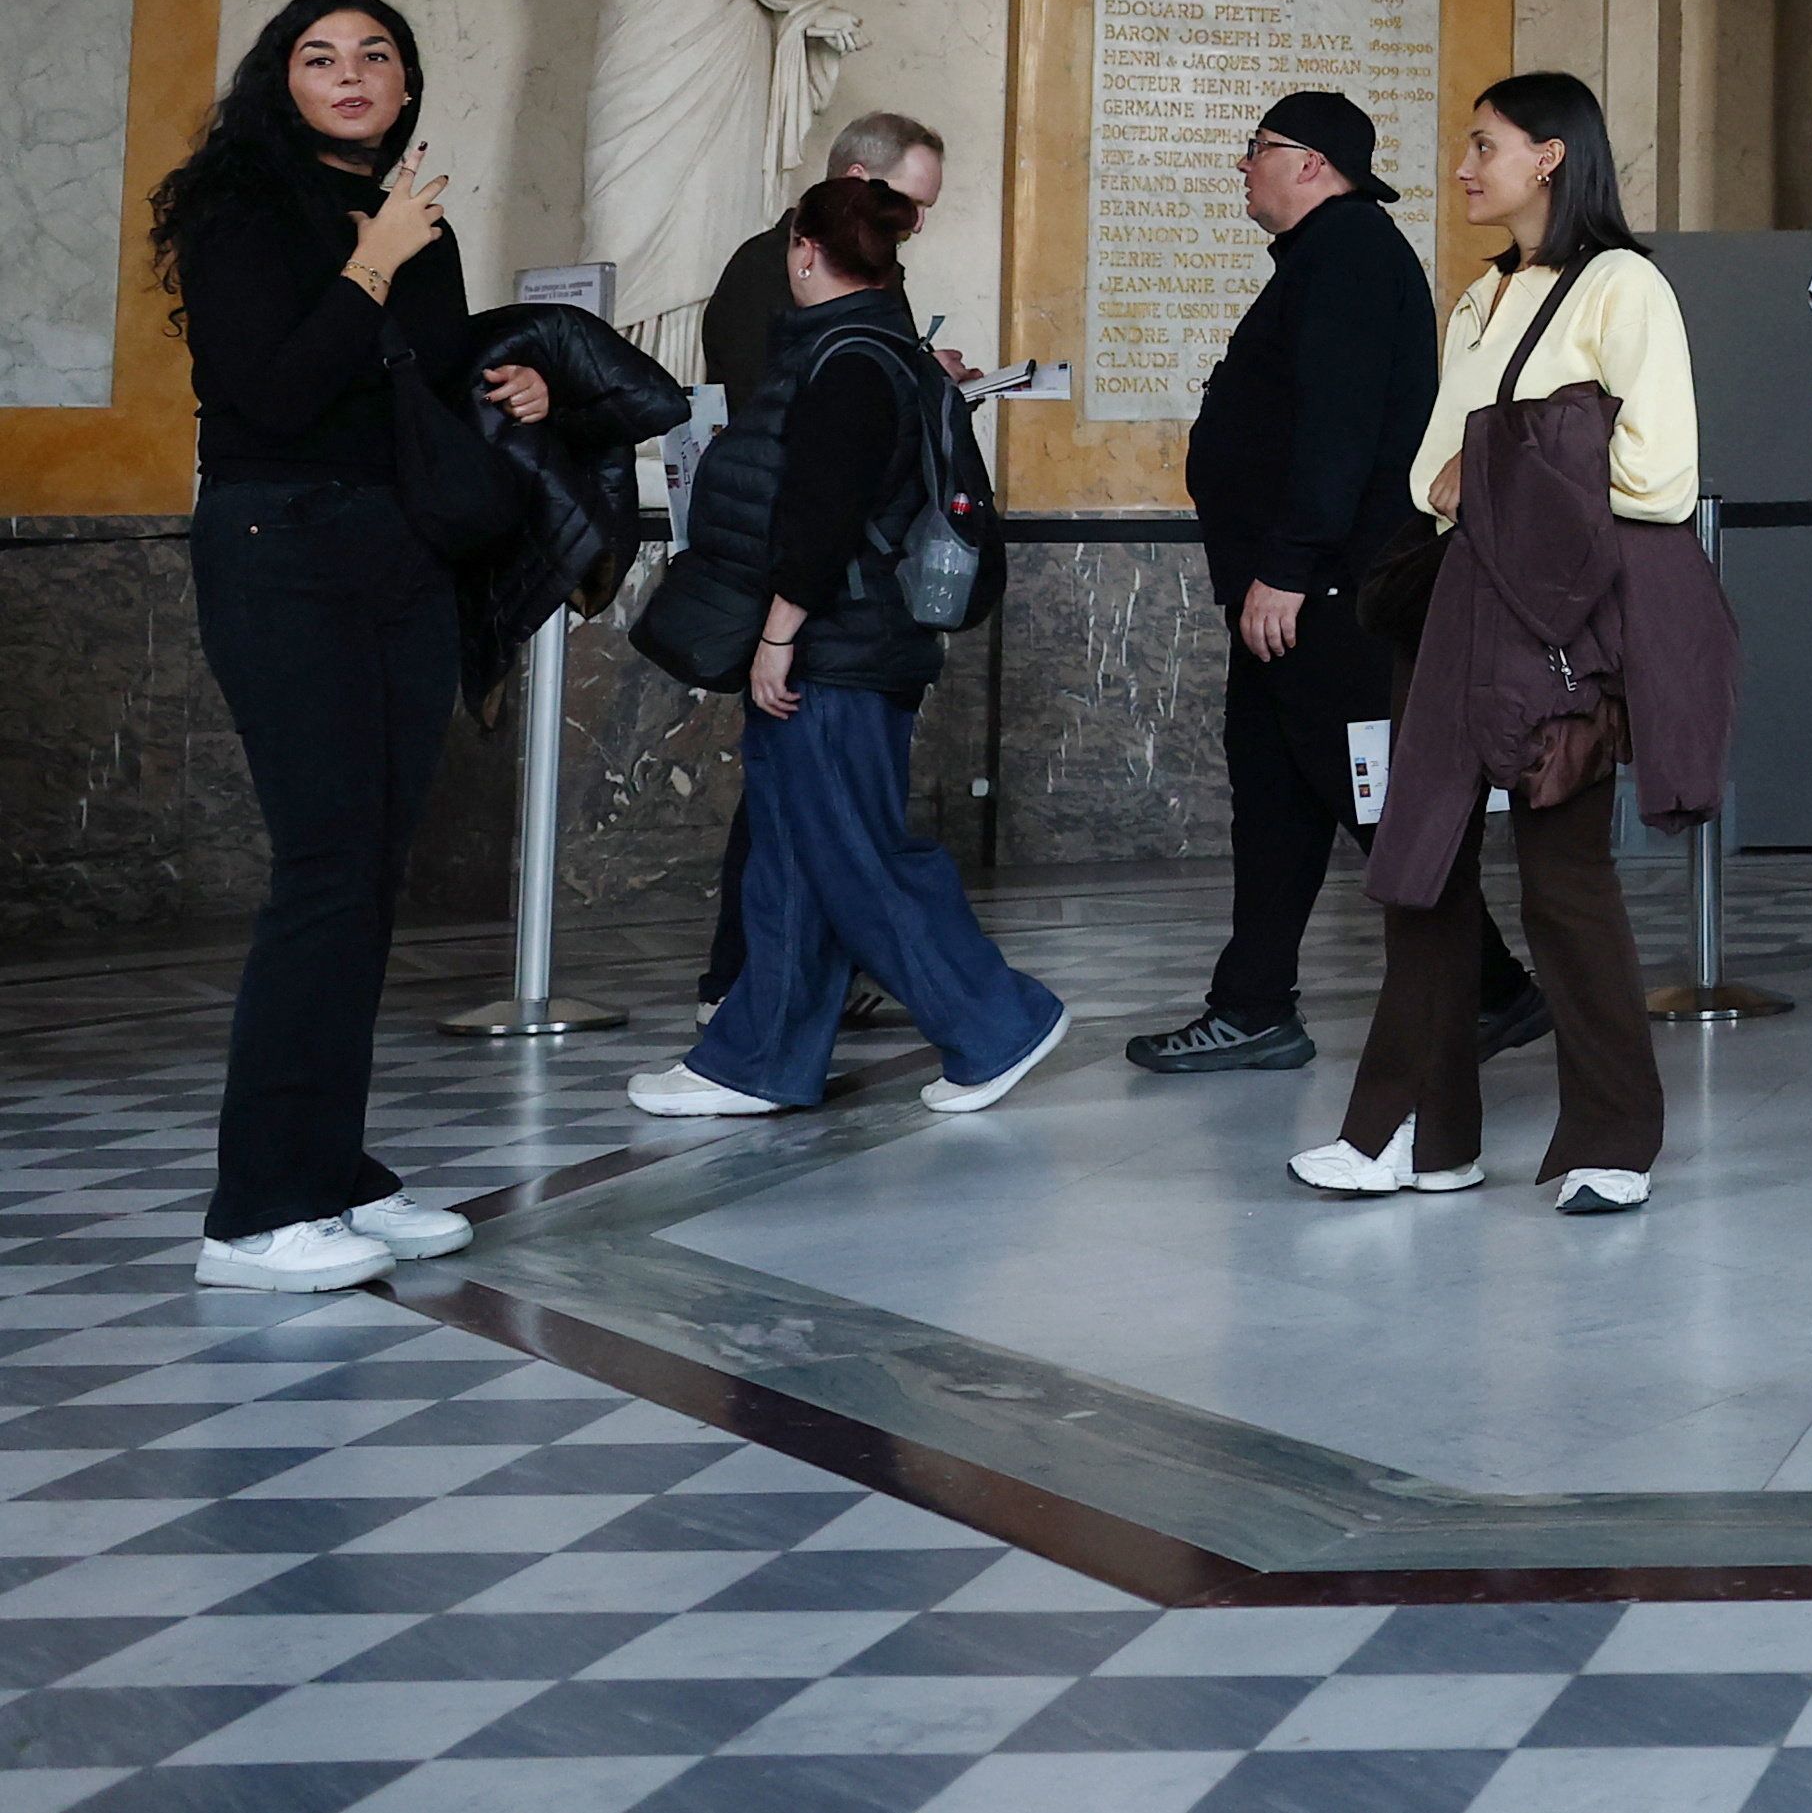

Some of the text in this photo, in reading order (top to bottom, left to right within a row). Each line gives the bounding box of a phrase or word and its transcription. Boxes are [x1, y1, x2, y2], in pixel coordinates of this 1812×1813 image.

[1103, 23, 1353, 51] BARON JOSEPH DE BAYE
[1102, 47, 1161, 68] HENRI
[1182, 52, 1261, 75] JACQUES
[1267, 56, 1289, 73] DE
[1296, 56, 1361, 76] MORGAN
[1102, 72, 1181, 93] DOCTEUR
[1102, 97, 1195, 119] GERMAINE
[1153, 150, 1222, 170] SUZANNE
[1100, 172, 1176, 194] FERNAND
[1099, 198, 1190, 220] BERNARD
[1098, 225, 1199, 246] RAYMOND
[1098, 249, 1254, 271] PIERRE MONTET
[1098, 325, 1169, 345] ANDRE
[1095, 349, 1179, 370] CLAUDE
[1095, 376, 1168, 396] ROMAN
